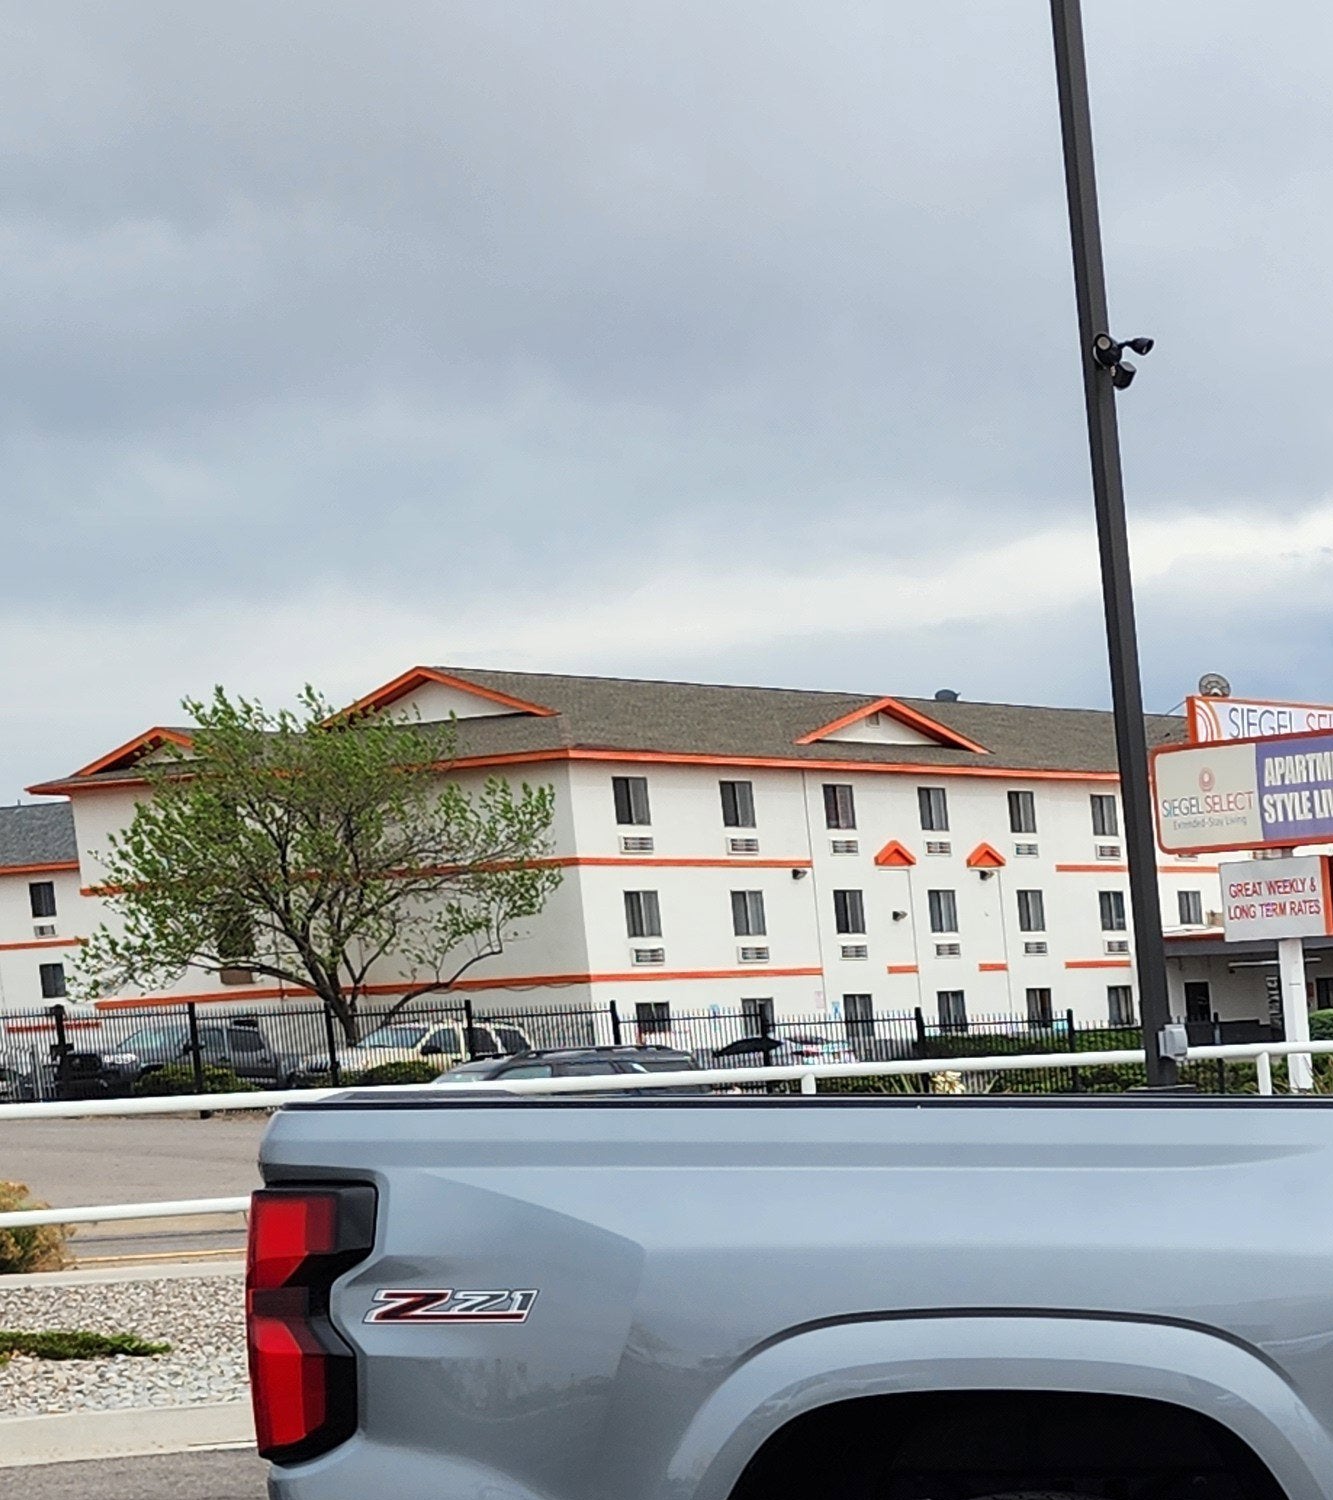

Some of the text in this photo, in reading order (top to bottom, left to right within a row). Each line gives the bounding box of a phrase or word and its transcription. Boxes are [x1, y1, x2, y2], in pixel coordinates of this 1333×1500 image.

[1162, 790, 1254, 818] SIEGEL SELECT
[1263, 789, 1313, 823] STYLE
[1229, 877, 1316, 898] GREAT WEEKLY &
[1228, 899, 1321, 920] LONG TERM RATES
[362, 1288, 540, 1325] Z71
